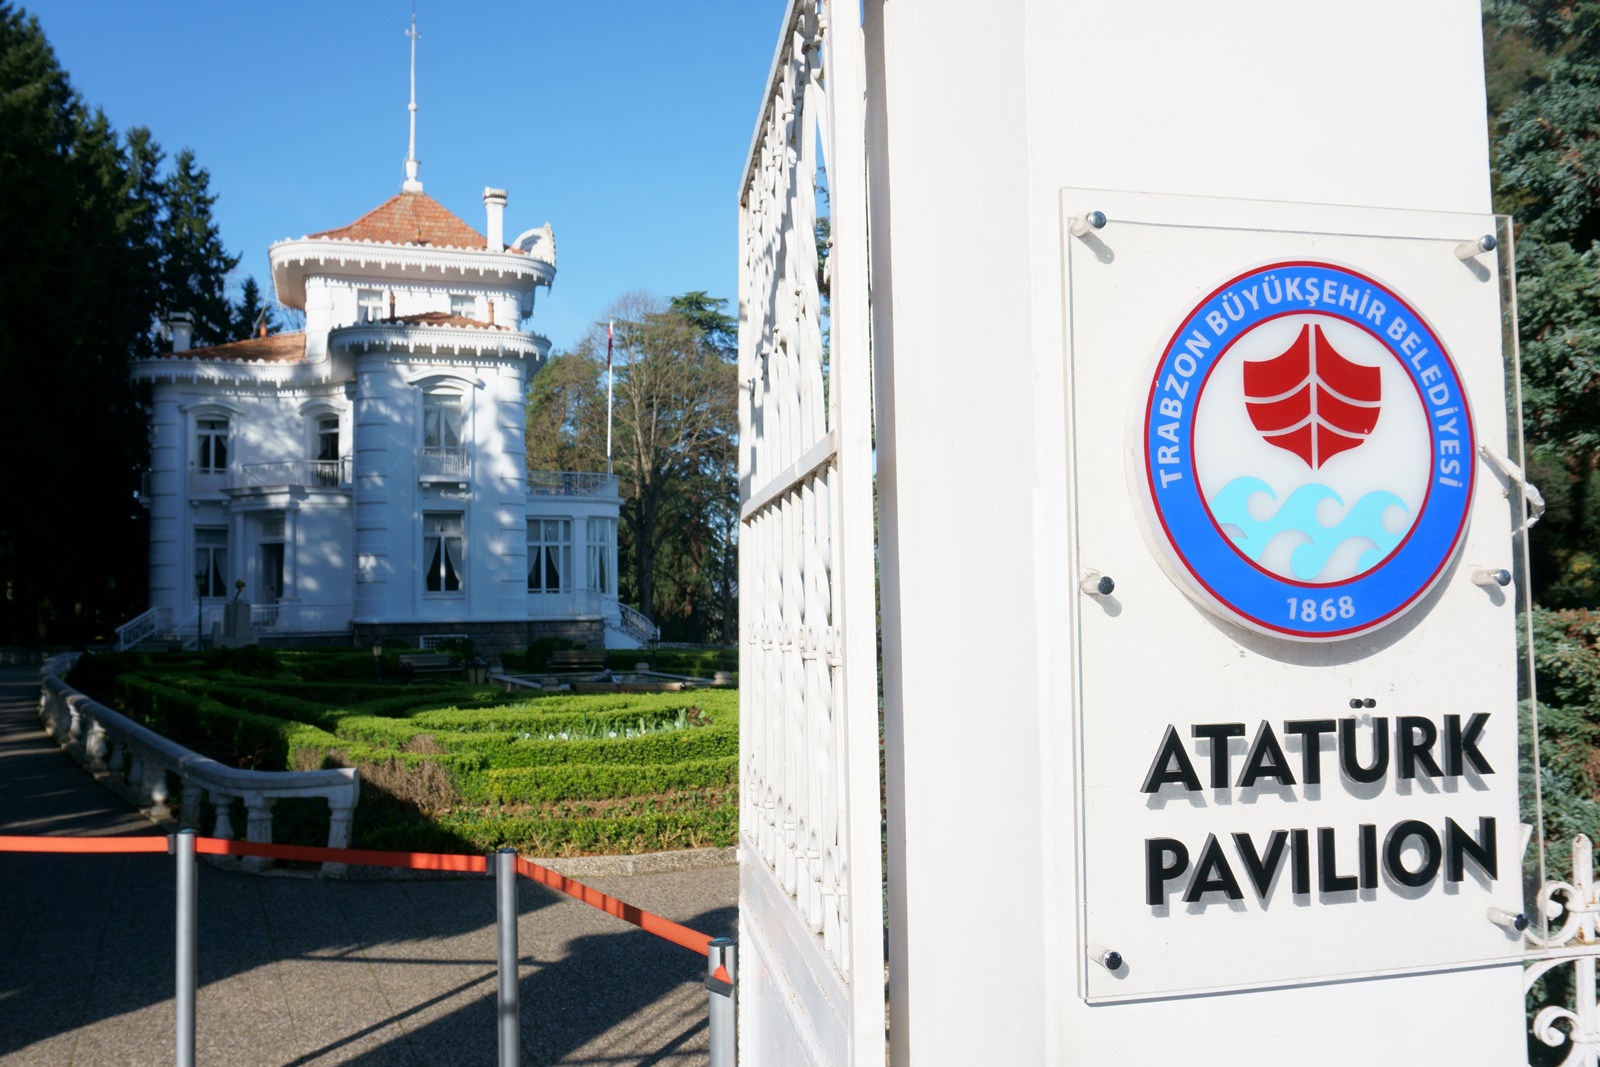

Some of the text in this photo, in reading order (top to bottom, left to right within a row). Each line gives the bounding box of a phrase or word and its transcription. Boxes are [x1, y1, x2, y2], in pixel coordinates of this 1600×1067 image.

[1157, 274, 1463, 489] TRABZON BÜYÜKŞEHİR BELEDİYESİ
[1286, 595, 1355, 622] 1868
[1140, 697, 1496, 794] ATATÜRK
[1145, 816, 1498, 906] PAVILION
